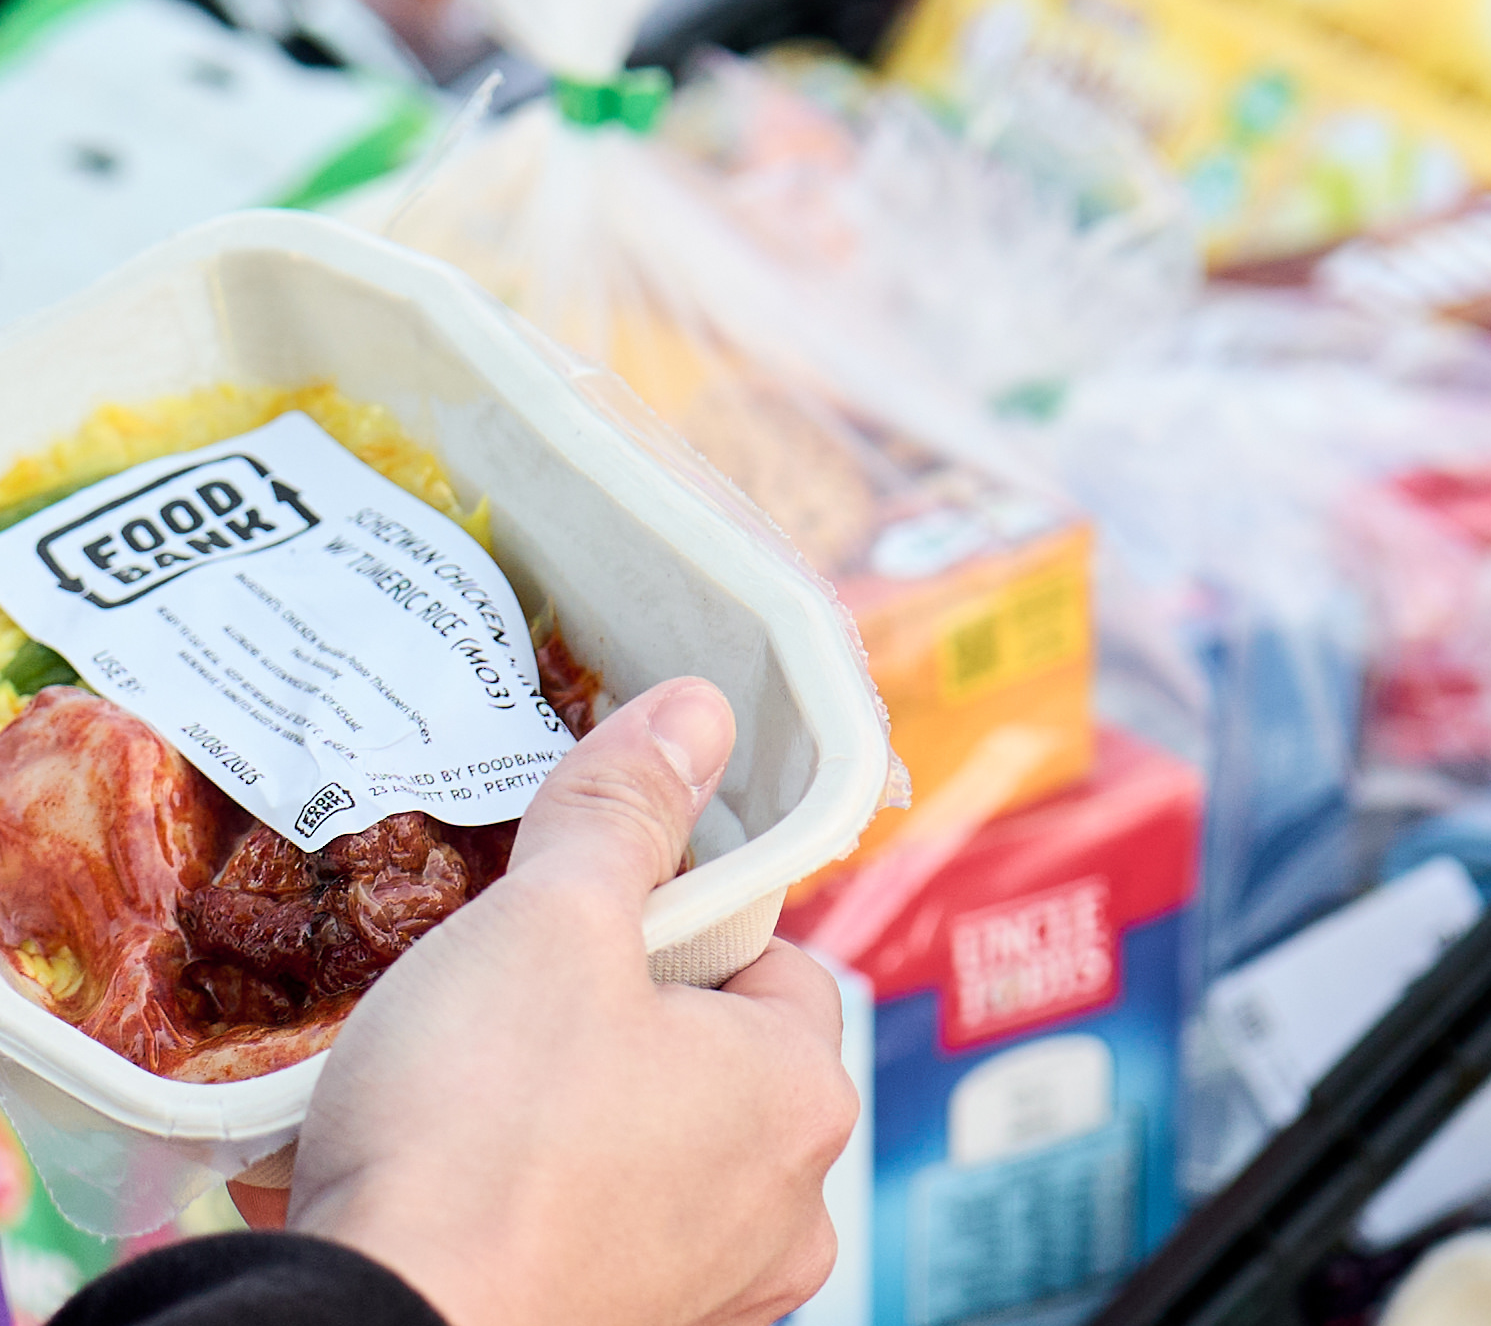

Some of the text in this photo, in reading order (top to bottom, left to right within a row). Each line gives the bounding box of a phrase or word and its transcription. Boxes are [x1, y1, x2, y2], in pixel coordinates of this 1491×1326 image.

[83, 481, 244, 571] FOOD
[111, 508, 277, 585] BANK
[347, 551, 429, 612] TUMERIC
[416, 599, 468, 638] RICE
[434, 563, 511, 648] CHICKEN
[92, 648, 129, 680] USE
[440, 767, 462, 783] BY
[467, 749, 560, 778] FOODBANK
[484, 769, 540, 795] PERTH
[302, 790, 335, 825] FOOD
[308, 795, 345, 829] BANK
